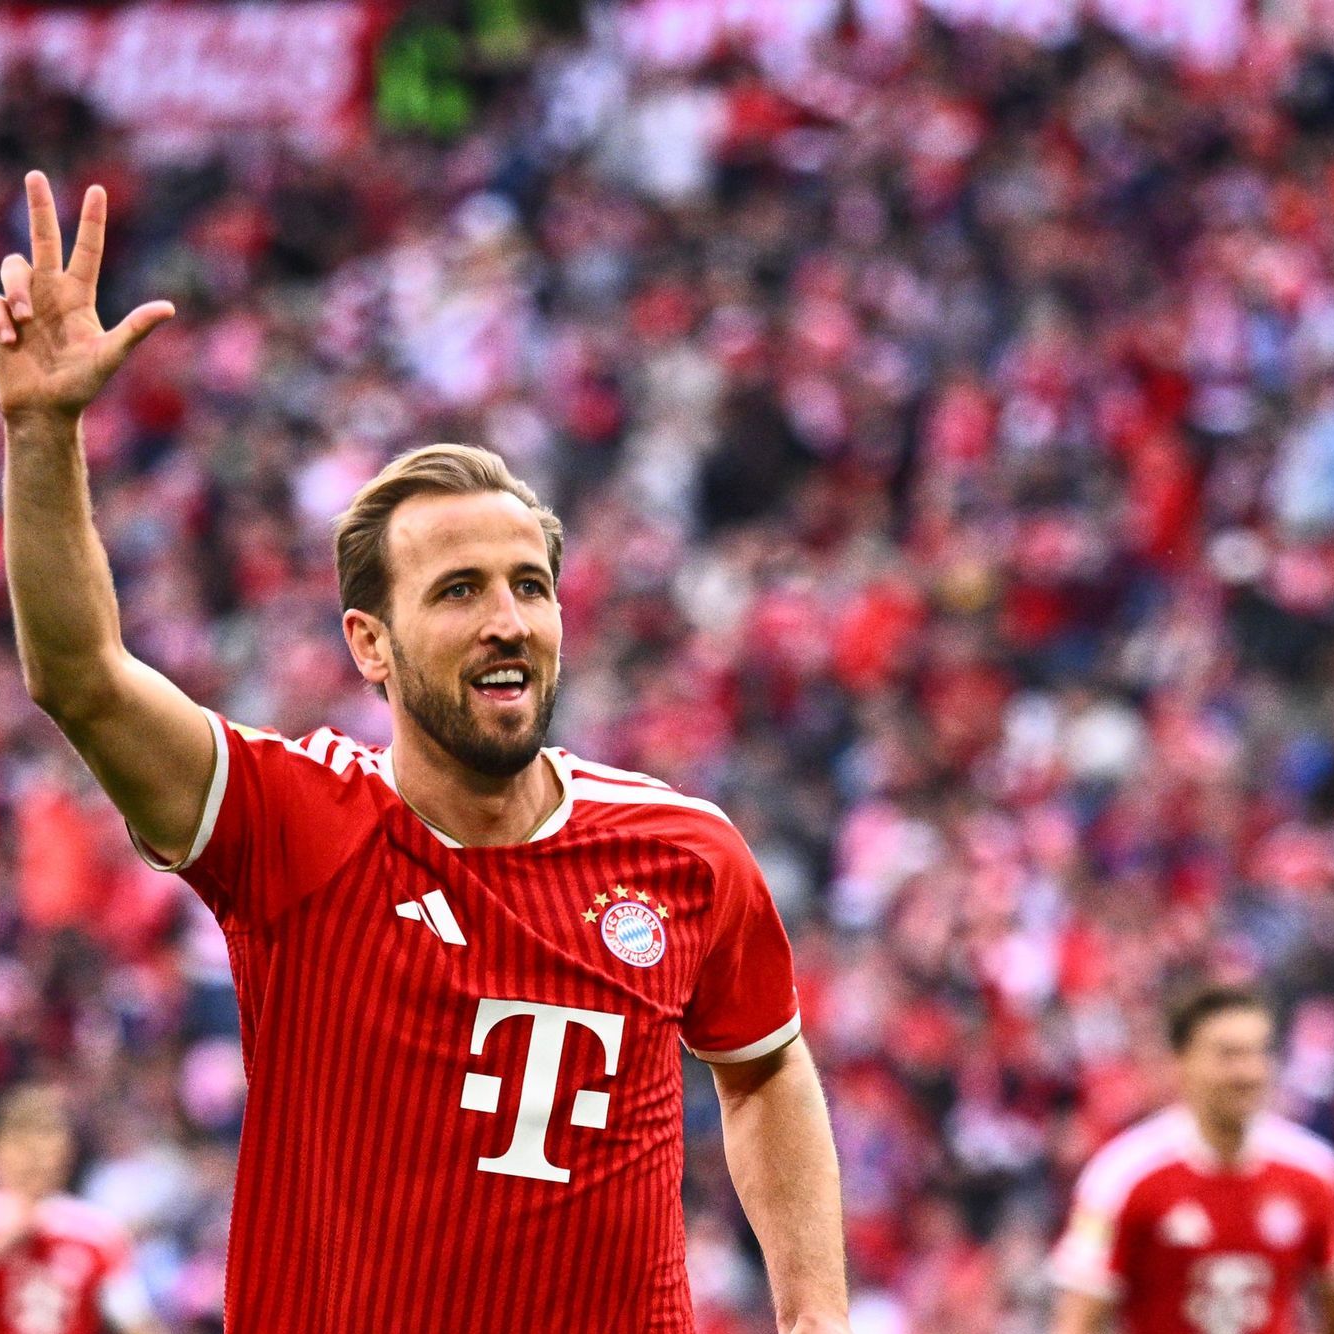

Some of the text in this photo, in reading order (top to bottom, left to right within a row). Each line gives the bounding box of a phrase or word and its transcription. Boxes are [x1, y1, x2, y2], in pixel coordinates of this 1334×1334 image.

[606, 906, 658, 931] FC BAYERN
[460, 998, 625, 1183] T
